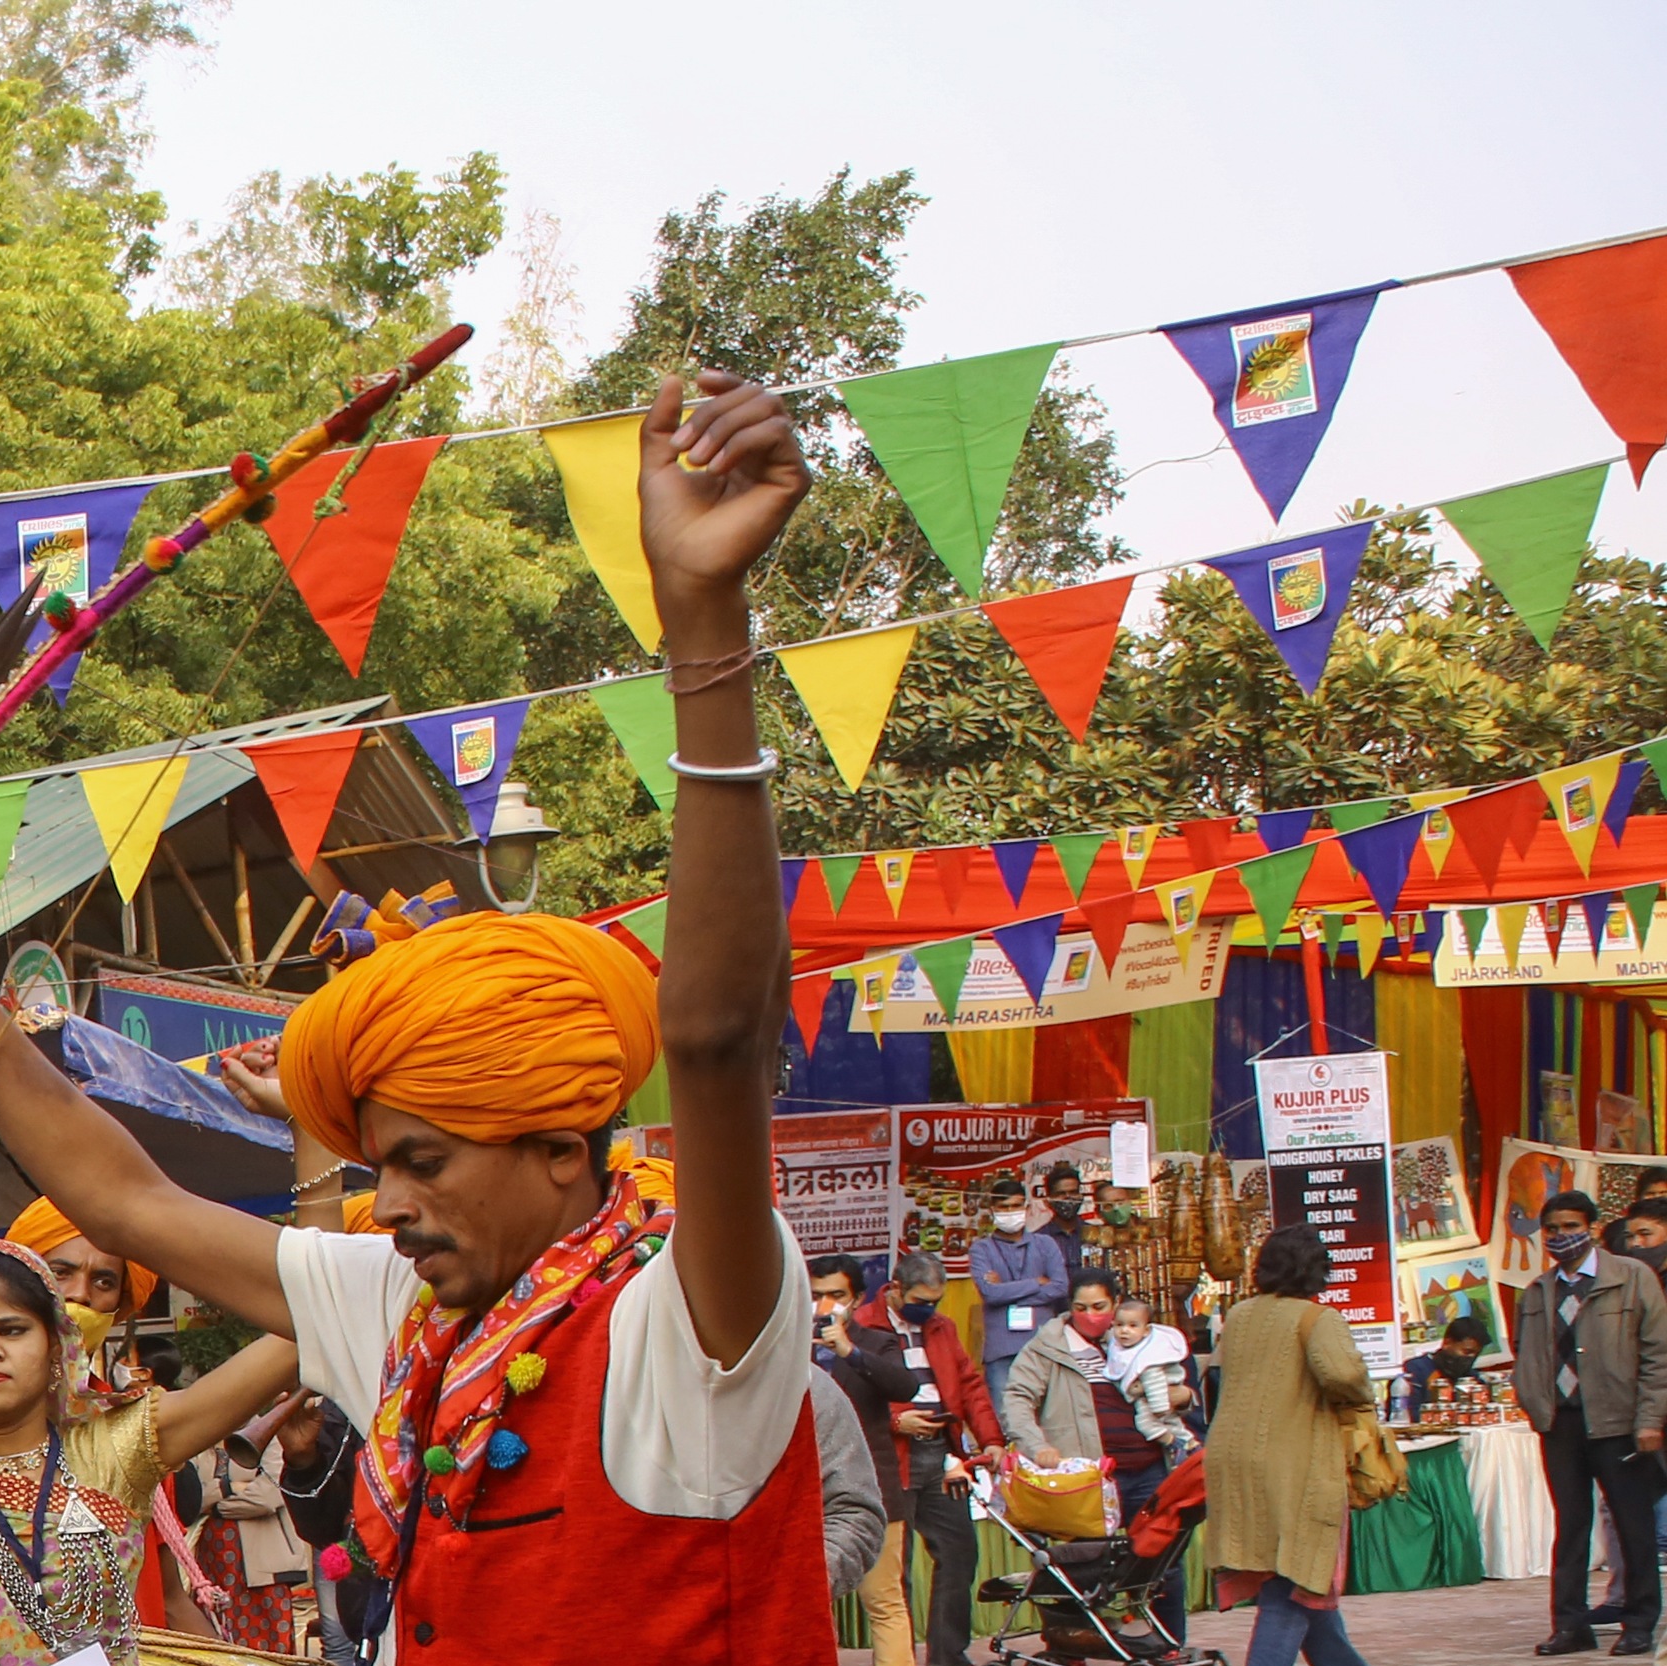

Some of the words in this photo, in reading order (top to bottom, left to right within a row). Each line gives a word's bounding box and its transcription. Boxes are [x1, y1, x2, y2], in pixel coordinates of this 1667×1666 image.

[1451, 964, 1544, 982] JHARKHAND
[923, 1004, 1054, 1028] MAHARASHTRA
[1274, 1091, 1325, 1109] KUJUR
[1331, 1087, 1370, 1104] PLUS
[934, 1118, 995, 1142] KUJUR
[1270, 1149, 1335, 1166] INDIGENOUS
[1336, 1146, 1383, 1162] PICKLES
[1308, 1169, 1345, 1184] HONEY
[1303, 1190, 1326, 1205] DRY
[1328, 1188, 1357, 1203] SAAG
[1307, 1210, 1332, 1224] DESI
[1334, 1209, 1356, 1222] DAL
[1318, 1289, 1351, 1304] SPICE
[1341, 1307, 1376, 1321] SAUCE
